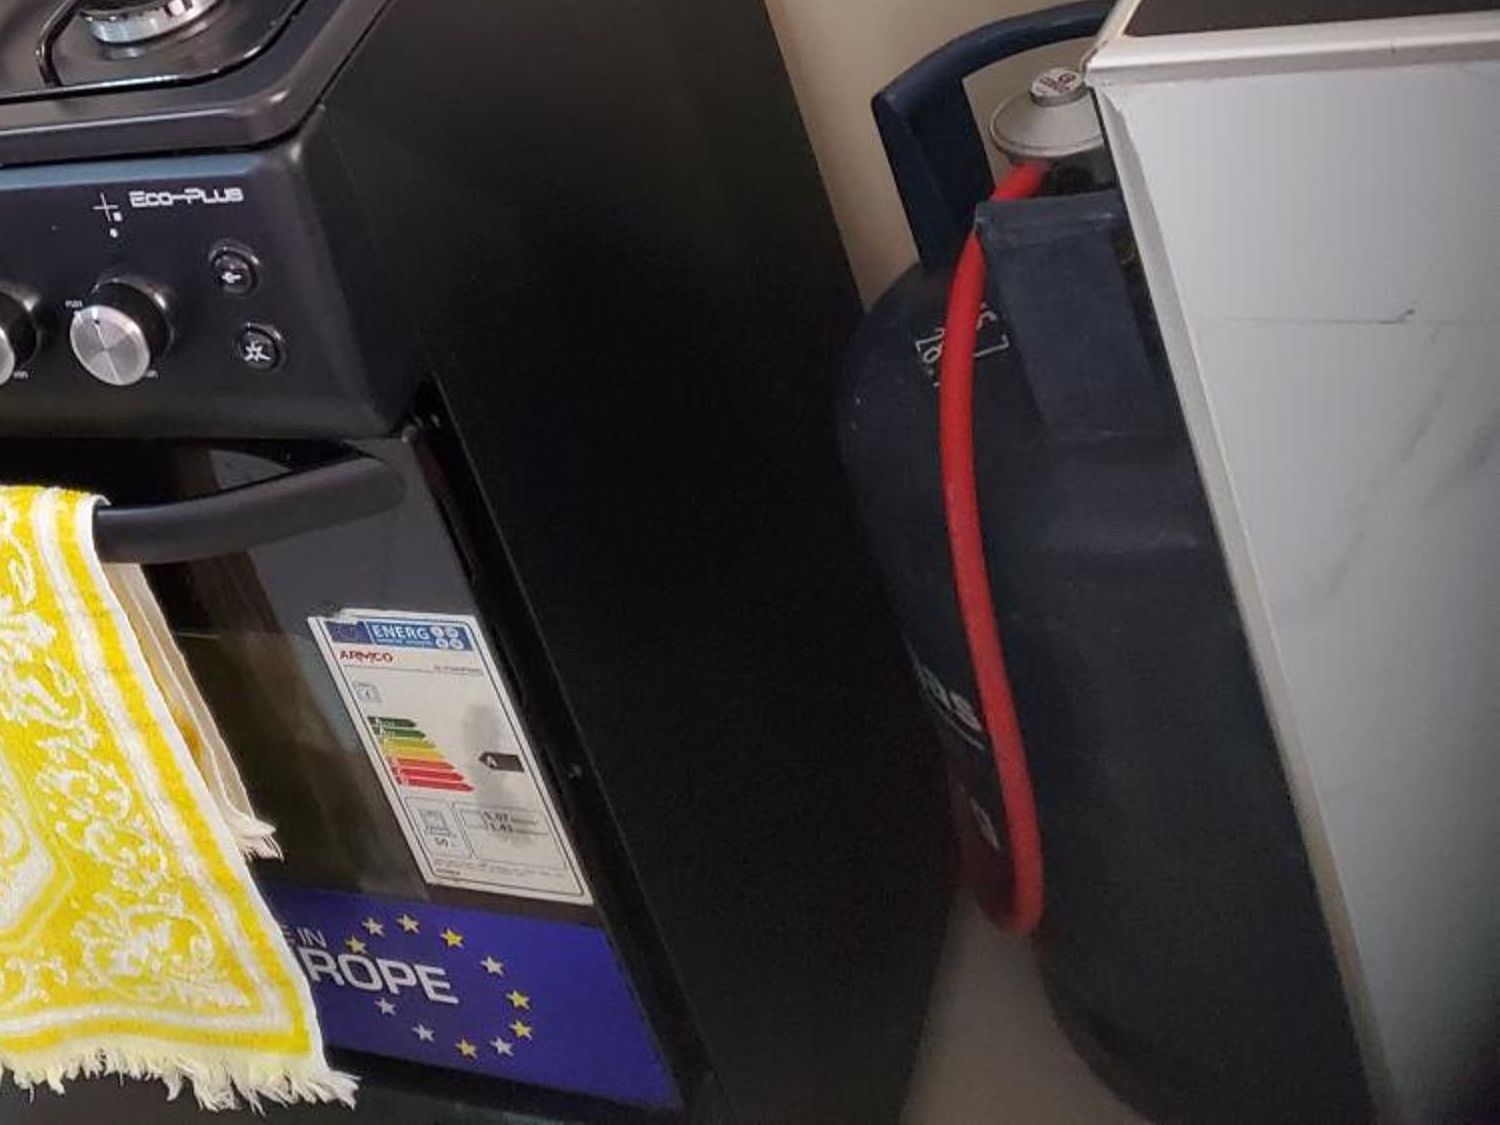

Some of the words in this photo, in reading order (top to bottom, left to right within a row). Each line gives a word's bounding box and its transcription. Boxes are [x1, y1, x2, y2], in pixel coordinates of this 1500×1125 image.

[371, 624, 430, 640] ENERG
[296, 927, 327, 949] IN
[298, 947, 460, 1005] ROPE
